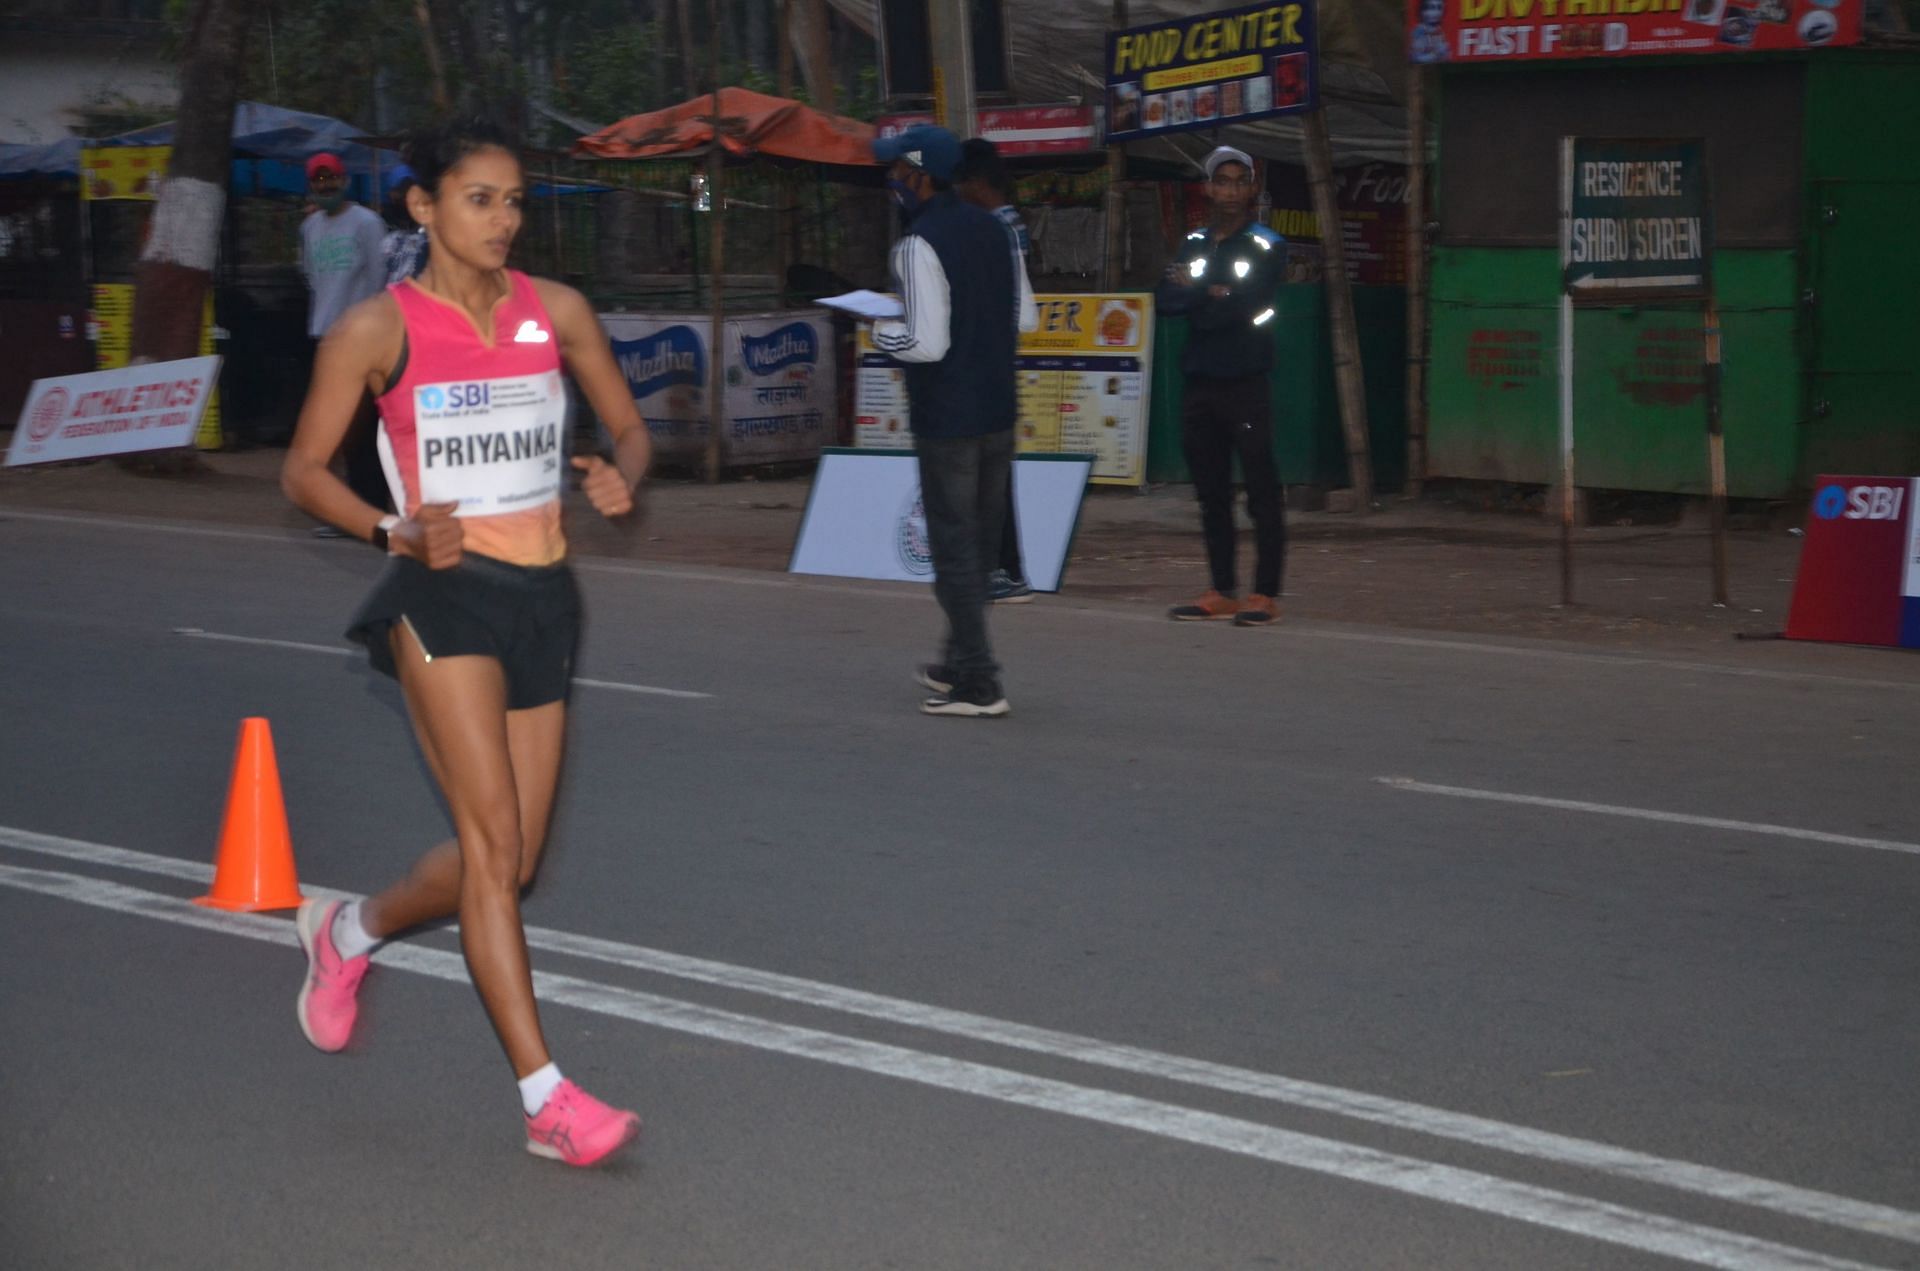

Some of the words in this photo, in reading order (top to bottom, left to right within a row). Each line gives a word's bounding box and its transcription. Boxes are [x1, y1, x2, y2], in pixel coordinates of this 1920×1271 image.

[1113, 28, 1181, 75] FOOD
[1185, 4, 1304, 60] CENTER
[1457, 25, 1534, 55] FAST
[1583, 160, 1683, 197] RESIDENCE
[1573, 217, 1629, 262] SHIBU
[1634, 216, 1703, 261] SOREN
[73, 378, 201, 417] ATHLETICS
[448, 383, 489, 409] SBI
[424, 422, 557, 470] PRIYANKA
[1843, 485, 1905, 520] SBI
